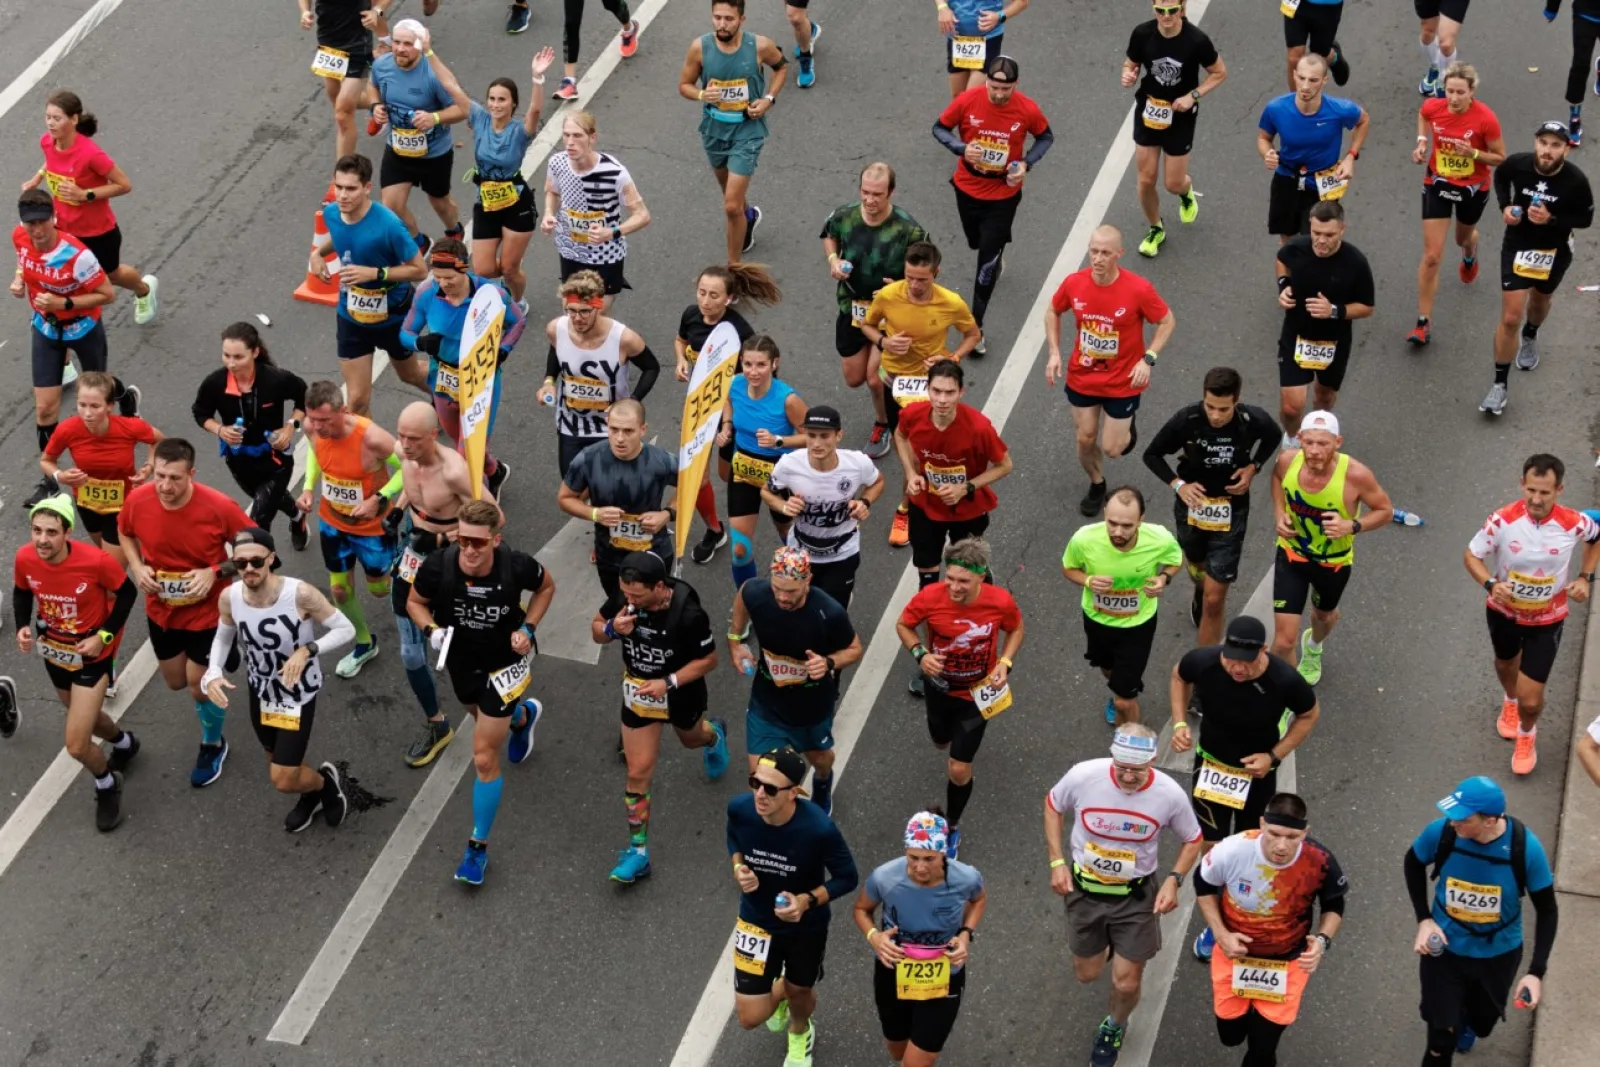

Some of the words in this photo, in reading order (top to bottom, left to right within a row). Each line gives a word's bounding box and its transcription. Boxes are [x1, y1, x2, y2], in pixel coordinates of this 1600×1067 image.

[956, 44, 982, 57] 9627
[317, 53, 344, 70] 5949
[1442, 155, 1469, 170] 1866
[480, 184, 514, 201] 15521
[351, 294, 382, 309] 7647
[1081, 331, 1118, 350] 15023
[570, 384, 603, 398] 2524
[84, 485, 119, 501] 1513
[325, 483, 358, 501] 7958
[1510, 583, 1552, 597] 12292
[1095, 593, 1138, 608] 10705
[41, 644, 76, 663] 2327
[1202, 768, 1250, 793] 10487
[1121, 822, 1149, 835] SPORT
[744, 854, 797, 872] PACEMAKER
[1092, 857, 1122, 874] 420
[1448, 889, 1498, 909] 14269
[903, 961, 944, 979] 7237
[1239, 968, 1280, 987] 4446
